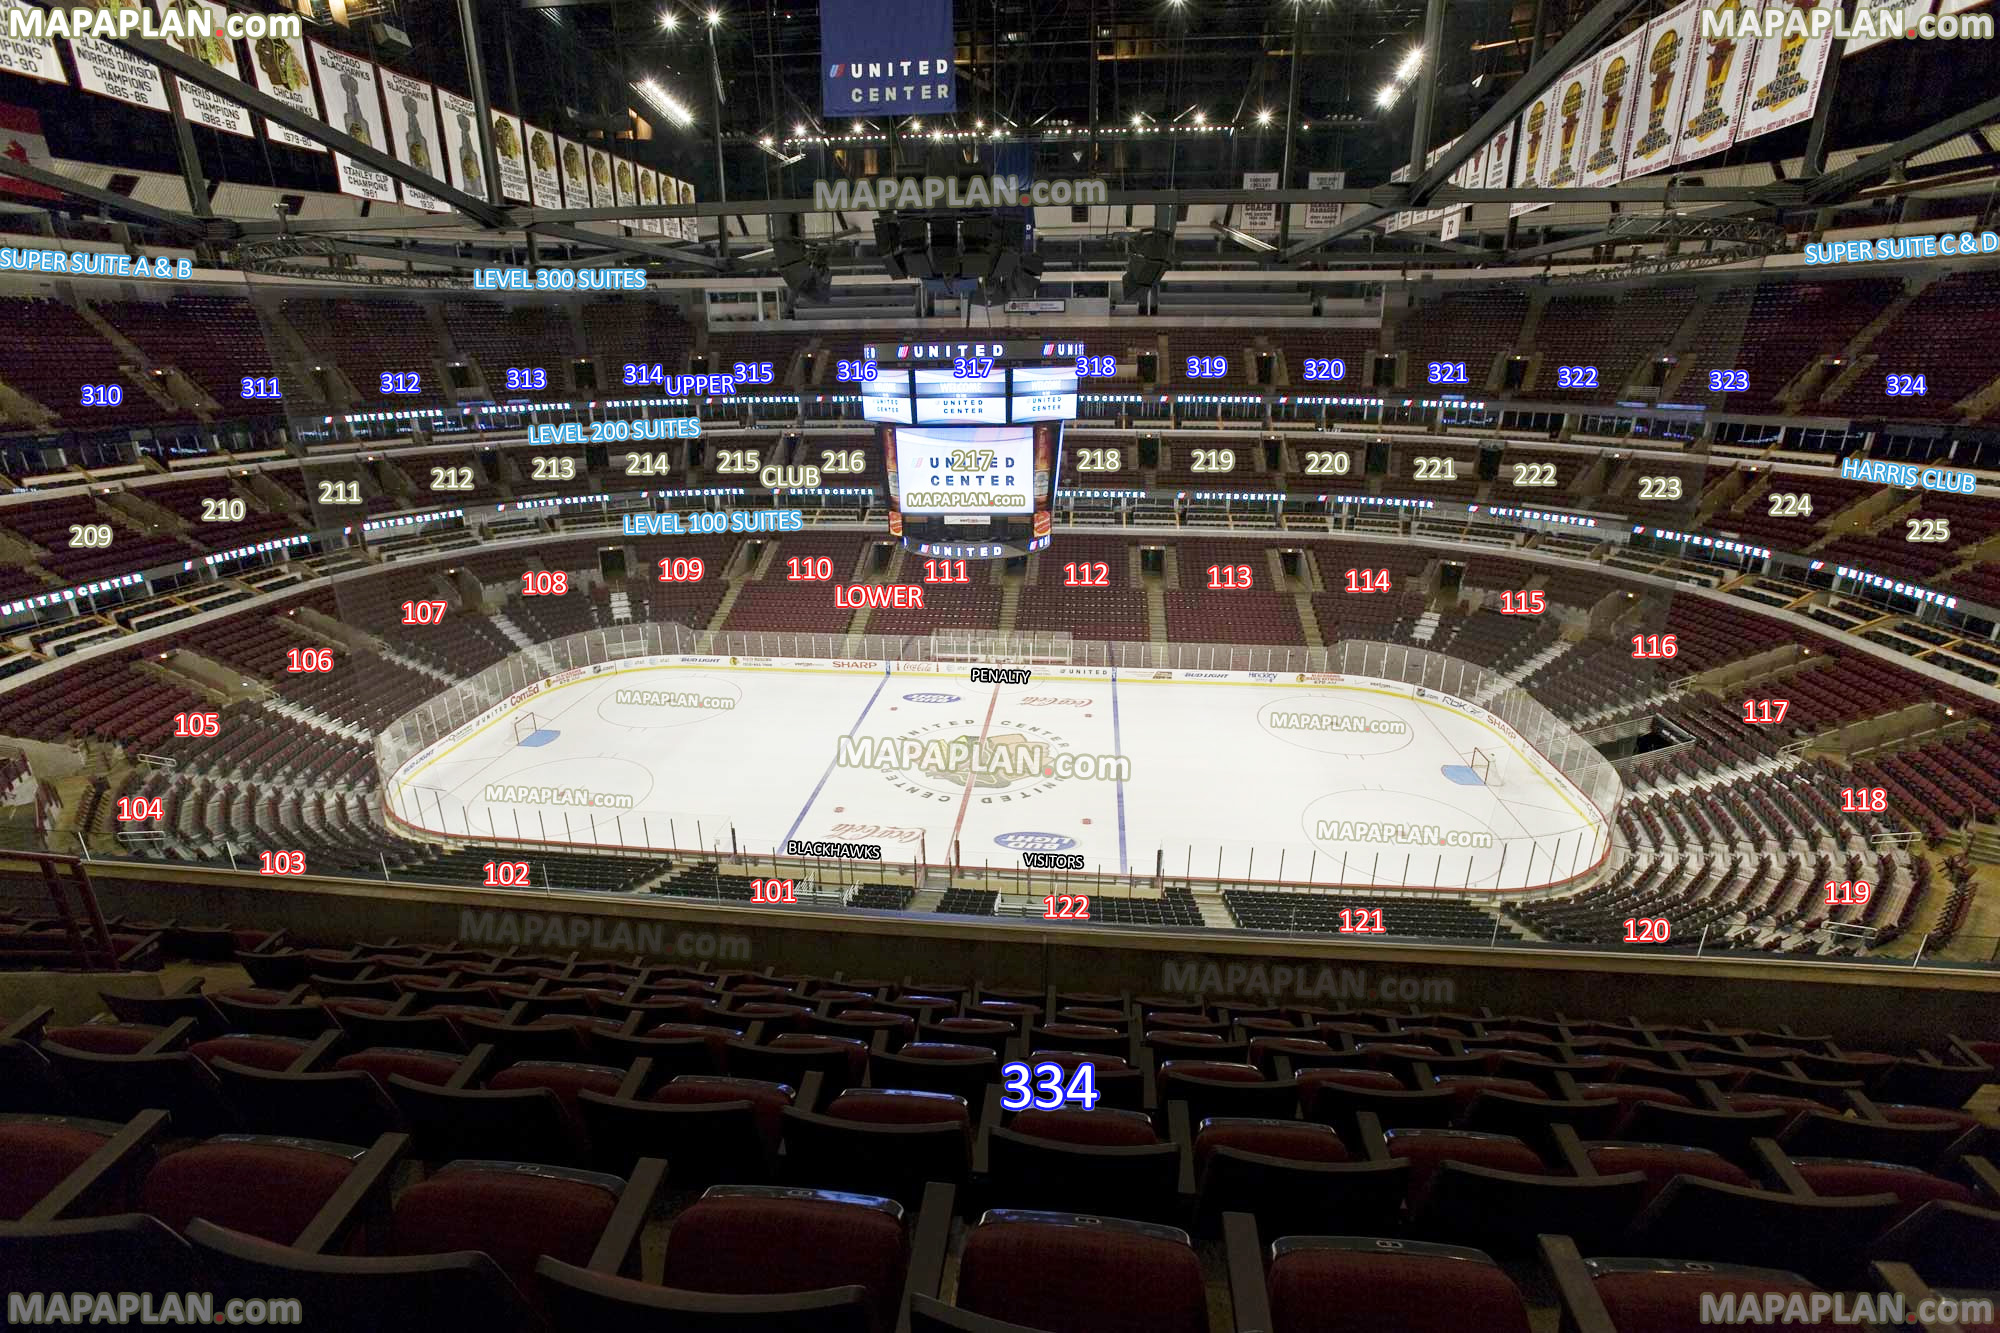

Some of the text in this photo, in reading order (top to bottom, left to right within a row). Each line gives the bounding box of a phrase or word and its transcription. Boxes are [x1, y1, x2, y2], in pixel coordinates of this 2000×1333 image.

[77, 47, 158, 82] NORRIS DIVISION
[320, 56, 370, 81] BLACKHAWKS
[327, 51, 360, 69] CHICAGO
[851, 59, 948, 78] UNITED
[93, 66, 152, 91] CHAMPIONS
[392, 75, 421, 91] CHICAGO
[851, 85, 948, 102] CENTER
[1752, 81, 1809, 111] CHAMPIONS
[192, 98, 240, 120] CHAMPIONS
[342, 165, 373, 181] STANLEY
[348, 176, 388, 192] CHAMPIONS
[914, 345, 1003, 357] UNITED
[931, 475, 1015, 486] CENTER
[932, 546, 1002, 557] UNITED
[832, 661, 877, 669] SHARP
[510, 684, 539, 706] ComEd
[1000, 720, 1070, 749] CENTER
[1487, 714, 1517, 741] SHARP
